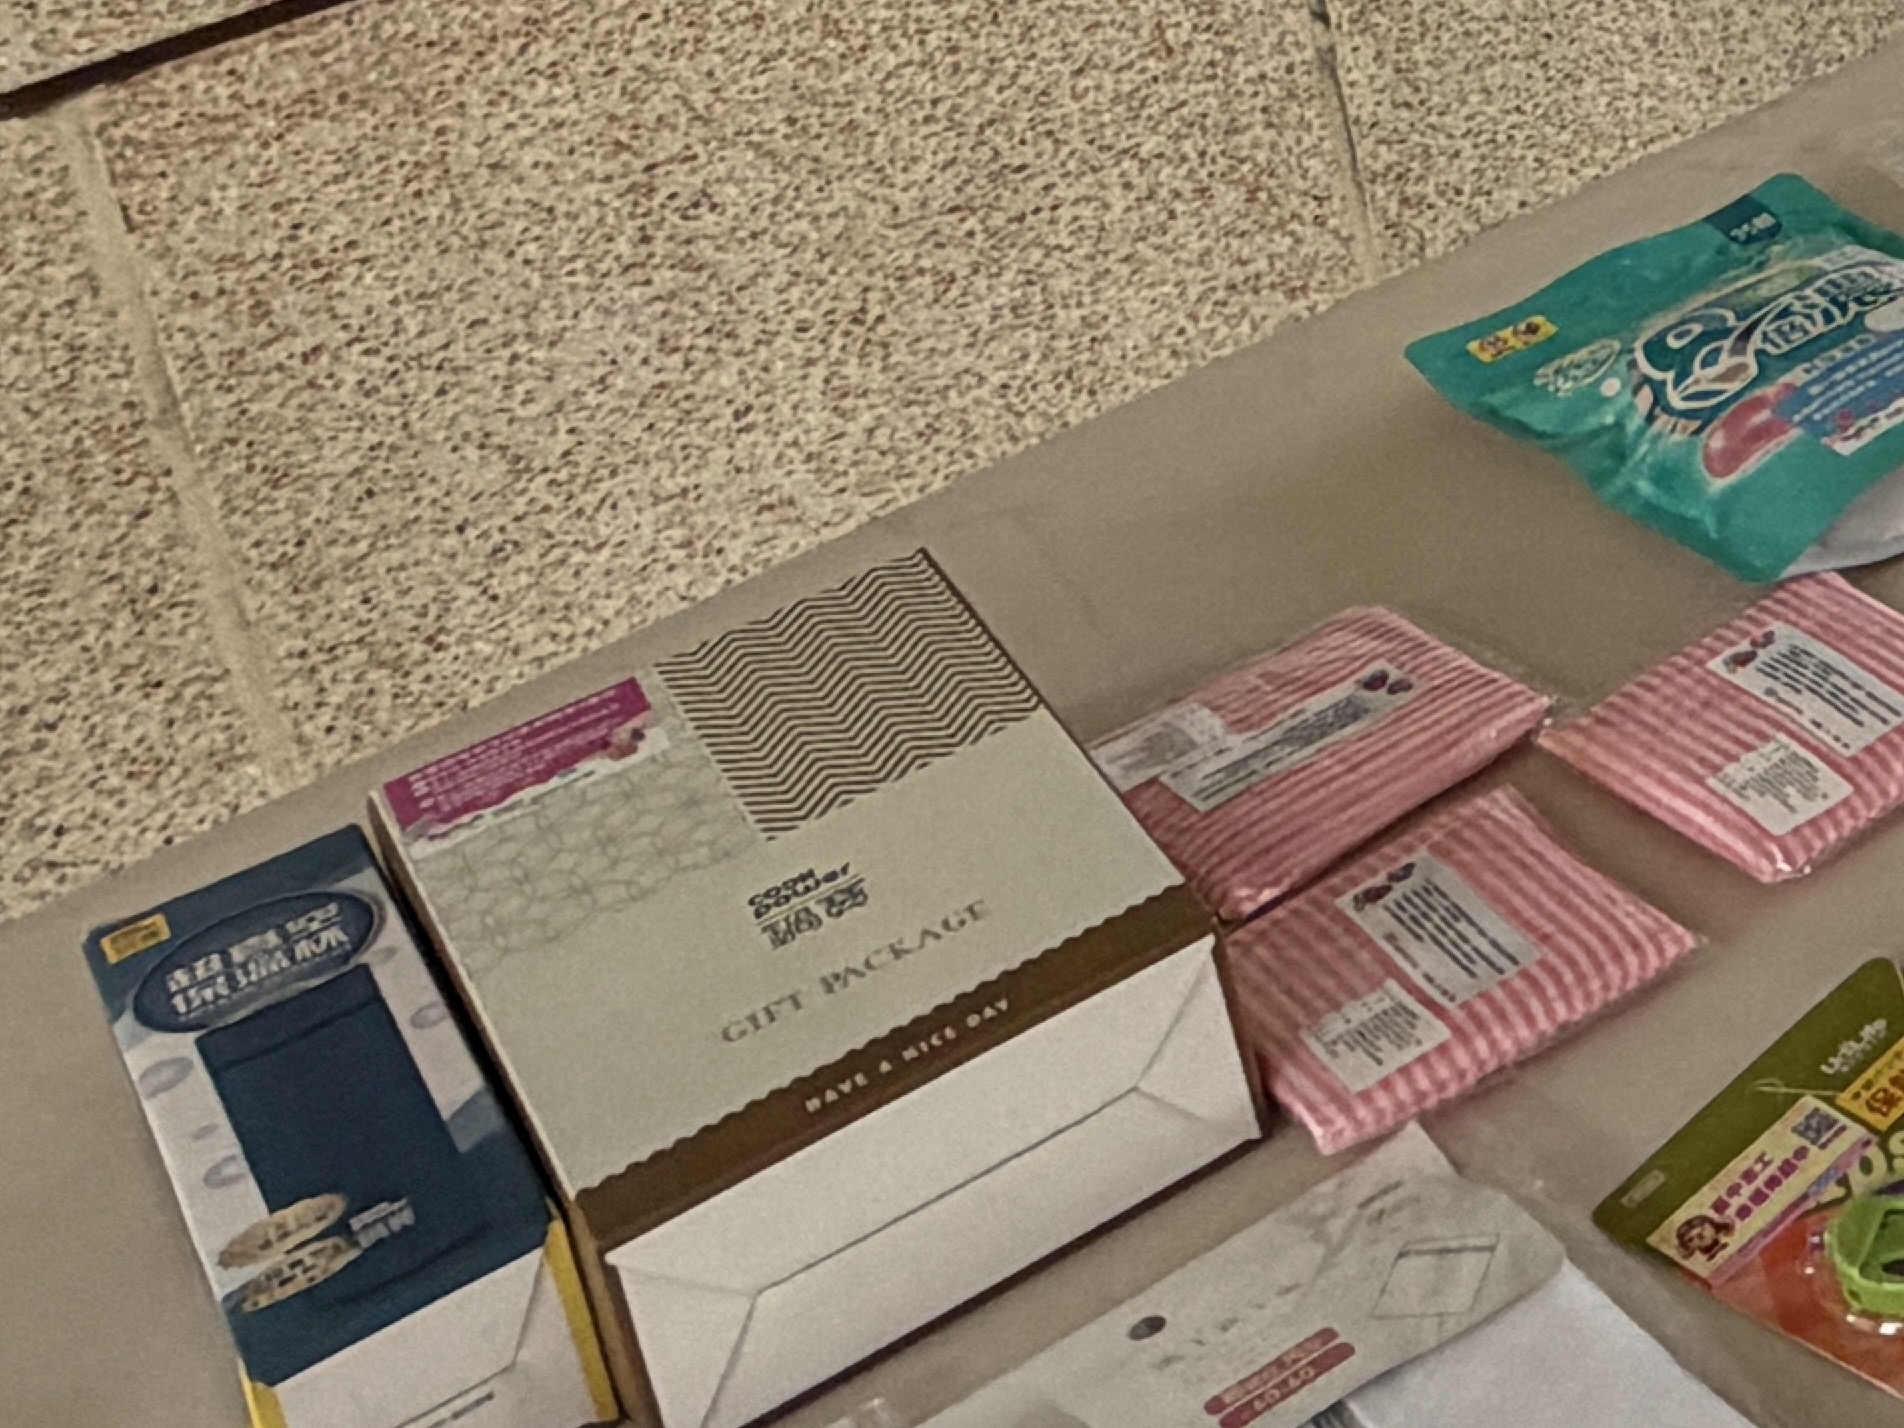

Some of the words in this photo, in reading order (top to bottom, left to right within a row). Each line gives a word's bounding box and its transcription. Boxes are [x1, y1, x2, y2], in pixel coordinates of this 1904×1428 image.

[723, 991, 805, 1044] GIFT
[819, 898, 989, 996] PACKAGE
[804, 1072, 868, 1113] HAVE
[901, 1025, 958, 1062] NICE
[965, 998, 1011, 1030] DAY
